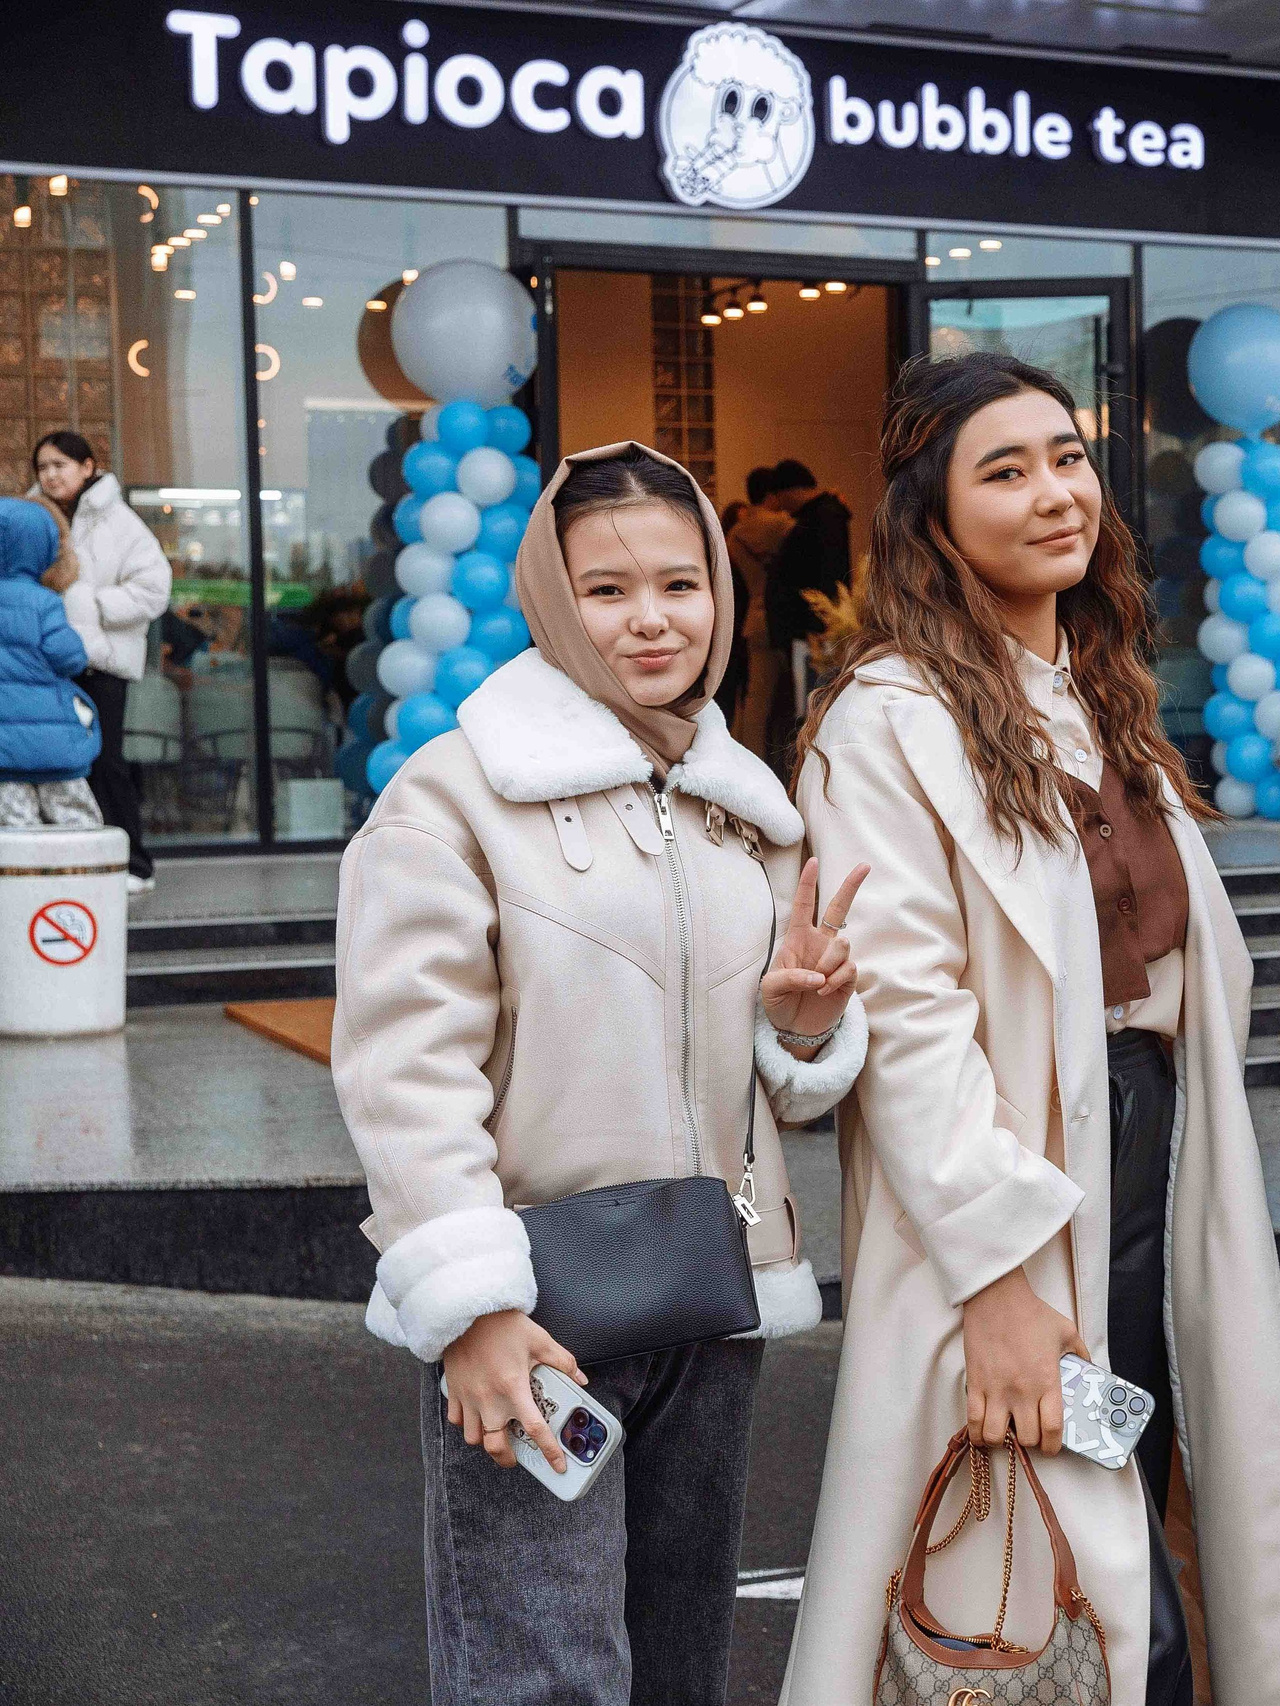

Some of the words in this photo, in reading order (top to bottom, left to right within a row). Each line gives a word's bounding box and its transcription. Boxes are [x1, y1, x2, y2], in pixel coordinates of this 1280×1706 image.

[167, 10, 645, 144] Tapioca
[829, 75, 1073, 160] bubble
[1093, 107, 1206, 170] tea
